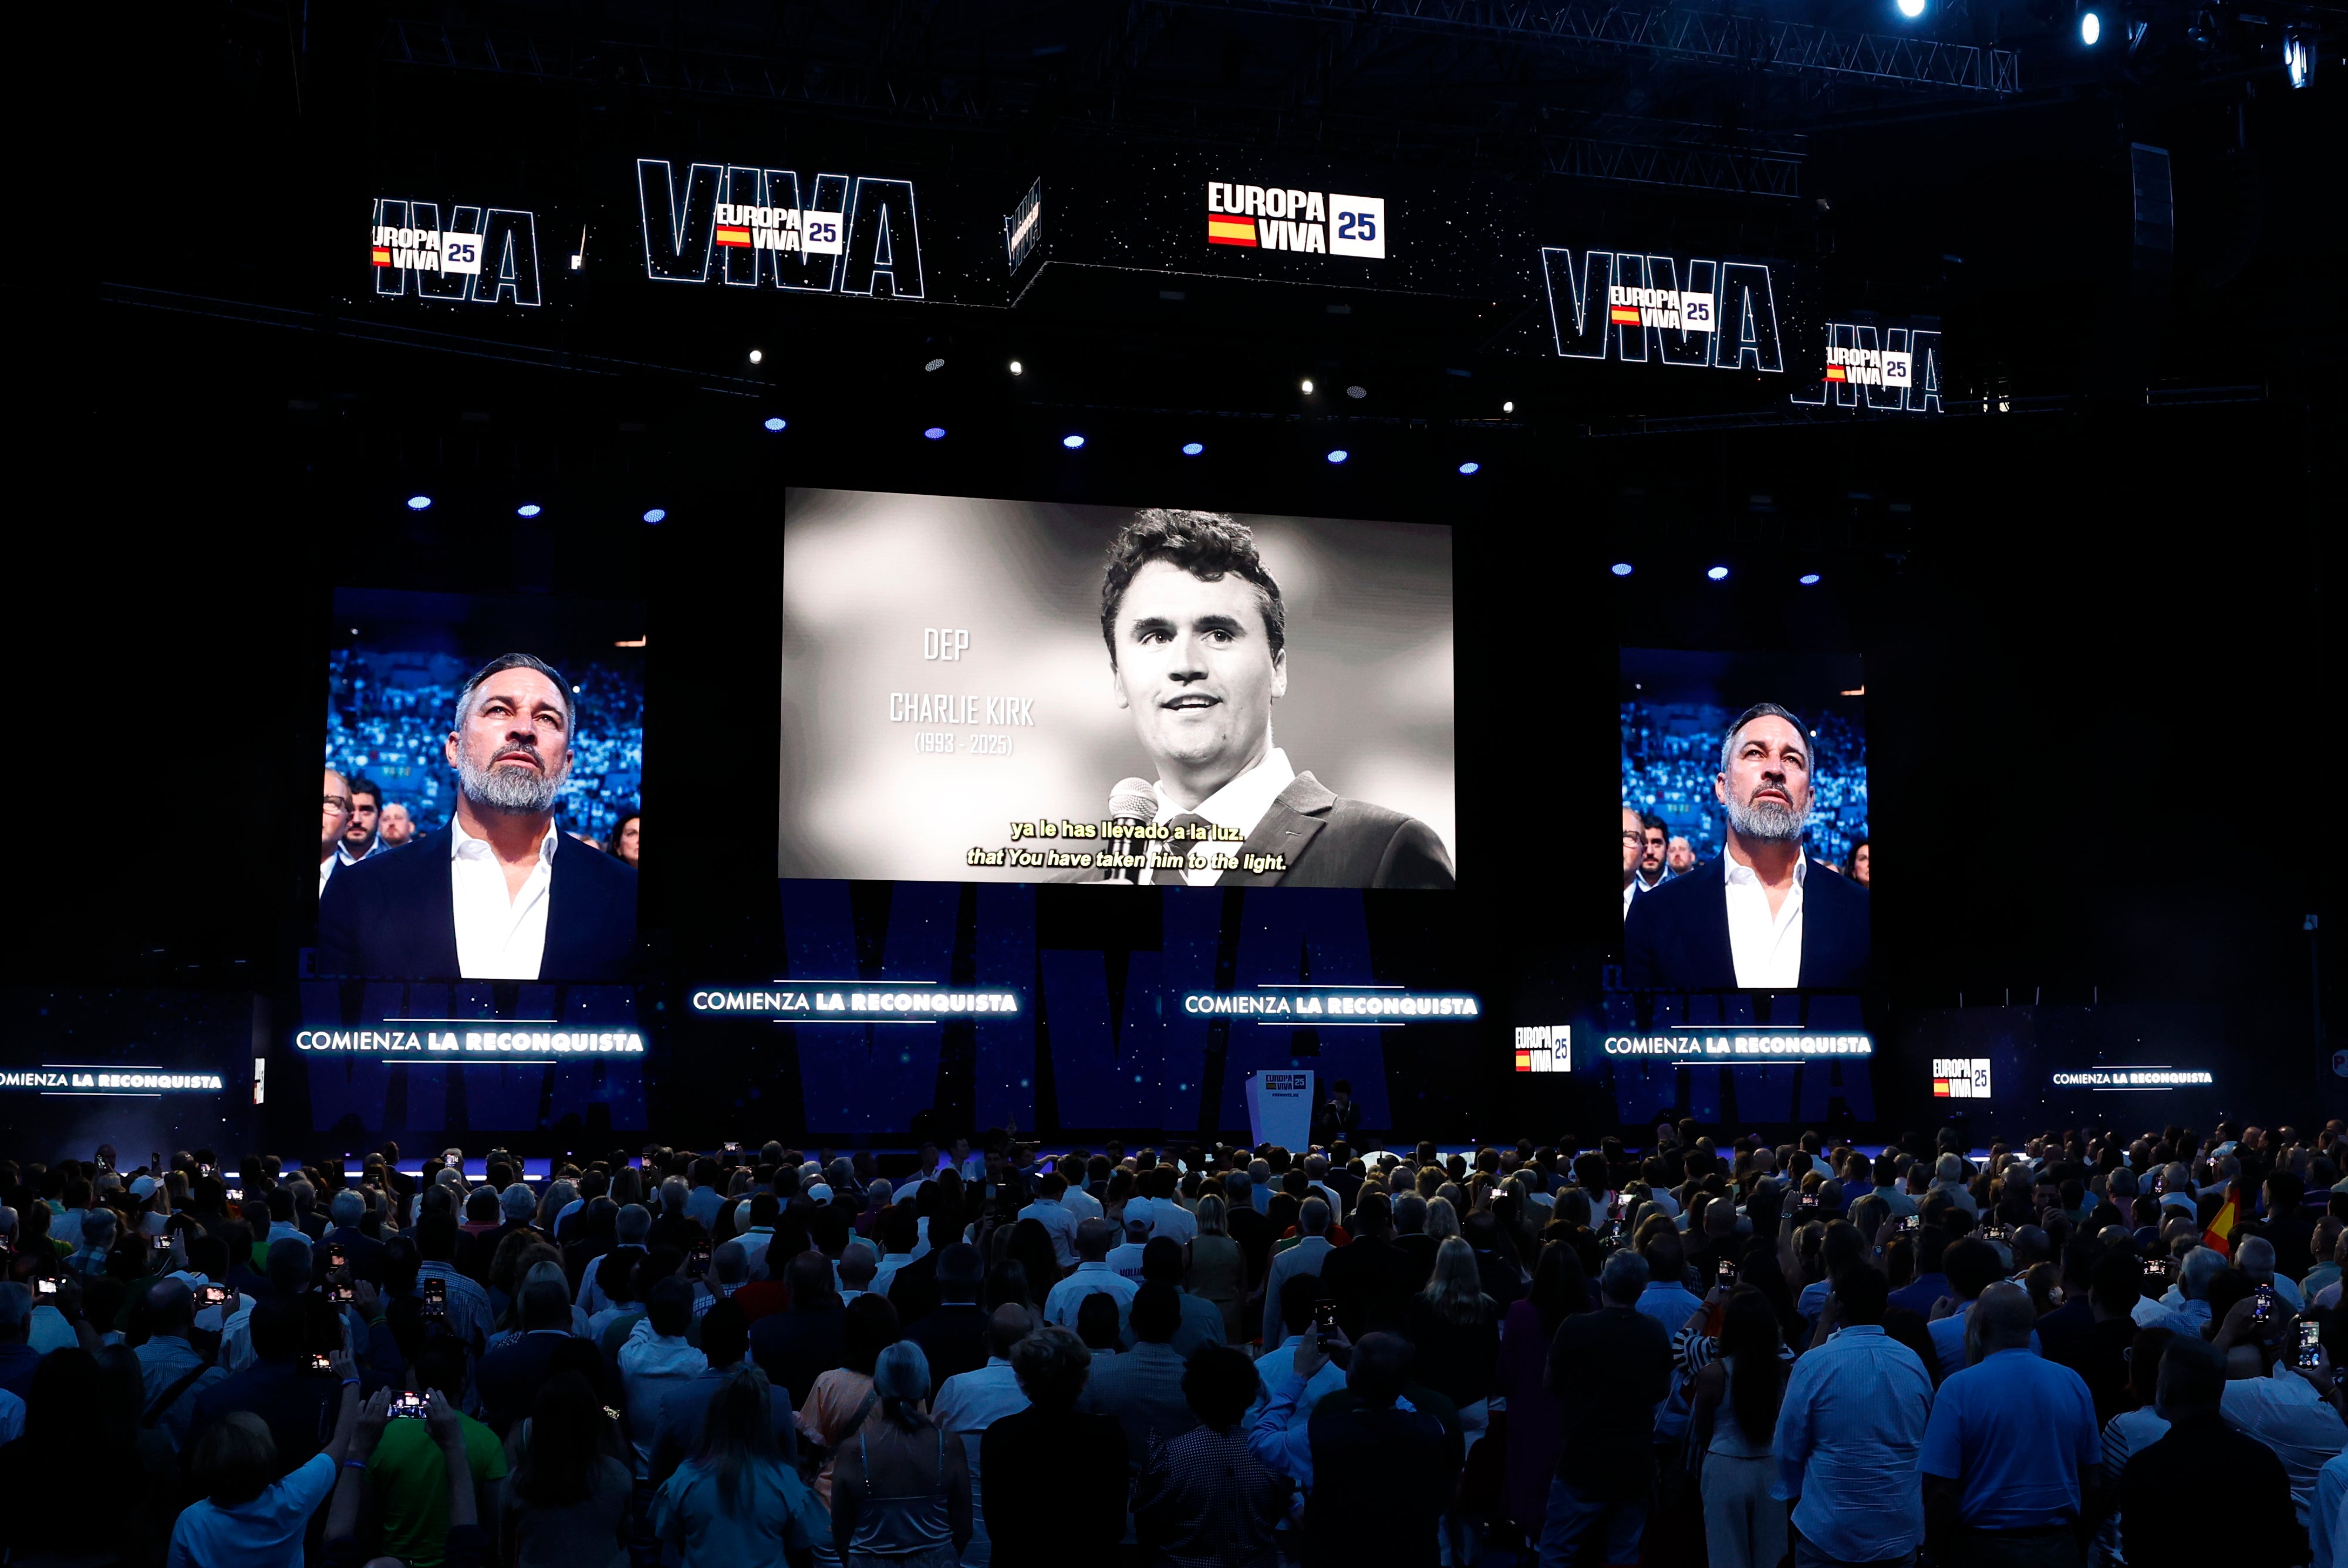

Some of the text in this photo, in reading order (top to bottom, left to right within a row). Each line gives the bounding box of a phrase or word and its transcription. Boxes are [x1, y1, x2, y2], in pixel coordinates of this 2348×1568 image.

[1209, 181, 1325, 222] EUROPA
[717, 203, 801, 229] EUROPA
[1338, 211, 1376, 241] 25
[372, 225, 440, 251] UROPA
[637, 158, 925, 298] VIVA
[809, 223, 836, 242] 25
[1259, 218, 1326, 254] VIVA
[752, 228, 800, 252] VIVA
[373, 198, 541, 306] IVA
[392, 248, 439, 271] VIVA
[448, 244, 475, 262] 25
[1610, 285, 1680, 309] EUROPA
[1542, 247, 1783, 372] VIVA
[1640, 308, 1681, 329] VIVA
[1686, 302, 1709, 320] 25
[1826, 346, 1881, 368] UROPA
[1846, 366, 1881, 385] VIVA
[1887, 361, 1907, 377] 25
[924, 628, 969, 660] DEP
[890, 692, 1034, 725] CHARLIE KIRK
[915, 732, 954, 753] (1993
[970, 734, 1013, 756] 2025)
[1011, 820, 1244, 840] ya le has llevado a la luz.
[967, 847, 1287, 873] that You have taken him to the light.
[693, 992, 1018, 1012] COMIENZA LA RECONQUISTA
[1185, 995, 1478, 1015] COMIENZA LA RECONQUISTA
[296, 1031, 644, 1052] COMIENZA LA RECONQUISTA
[1516, 1026, 1551, 1049] EUROPA
[1555, 1038, 1568, 1059] 25
[1605, 1037, 1871, 1054] COMIENZA LA RECONQUISTA
[1530, 1049, 1552, 1072] VIVA
[1933, 1059, 1971, 1078] EUROPA
[72, 1074, 94, 1087] LA
[98, 1074, 222, 1089] RECONQUISTA
[1949, 1078, 1971, 1097] VIVA
[1974, 1069, 1988, 1087] 25
[2053, 1073, 2212, 1084] COMIENZA LA RECONQUISTA
